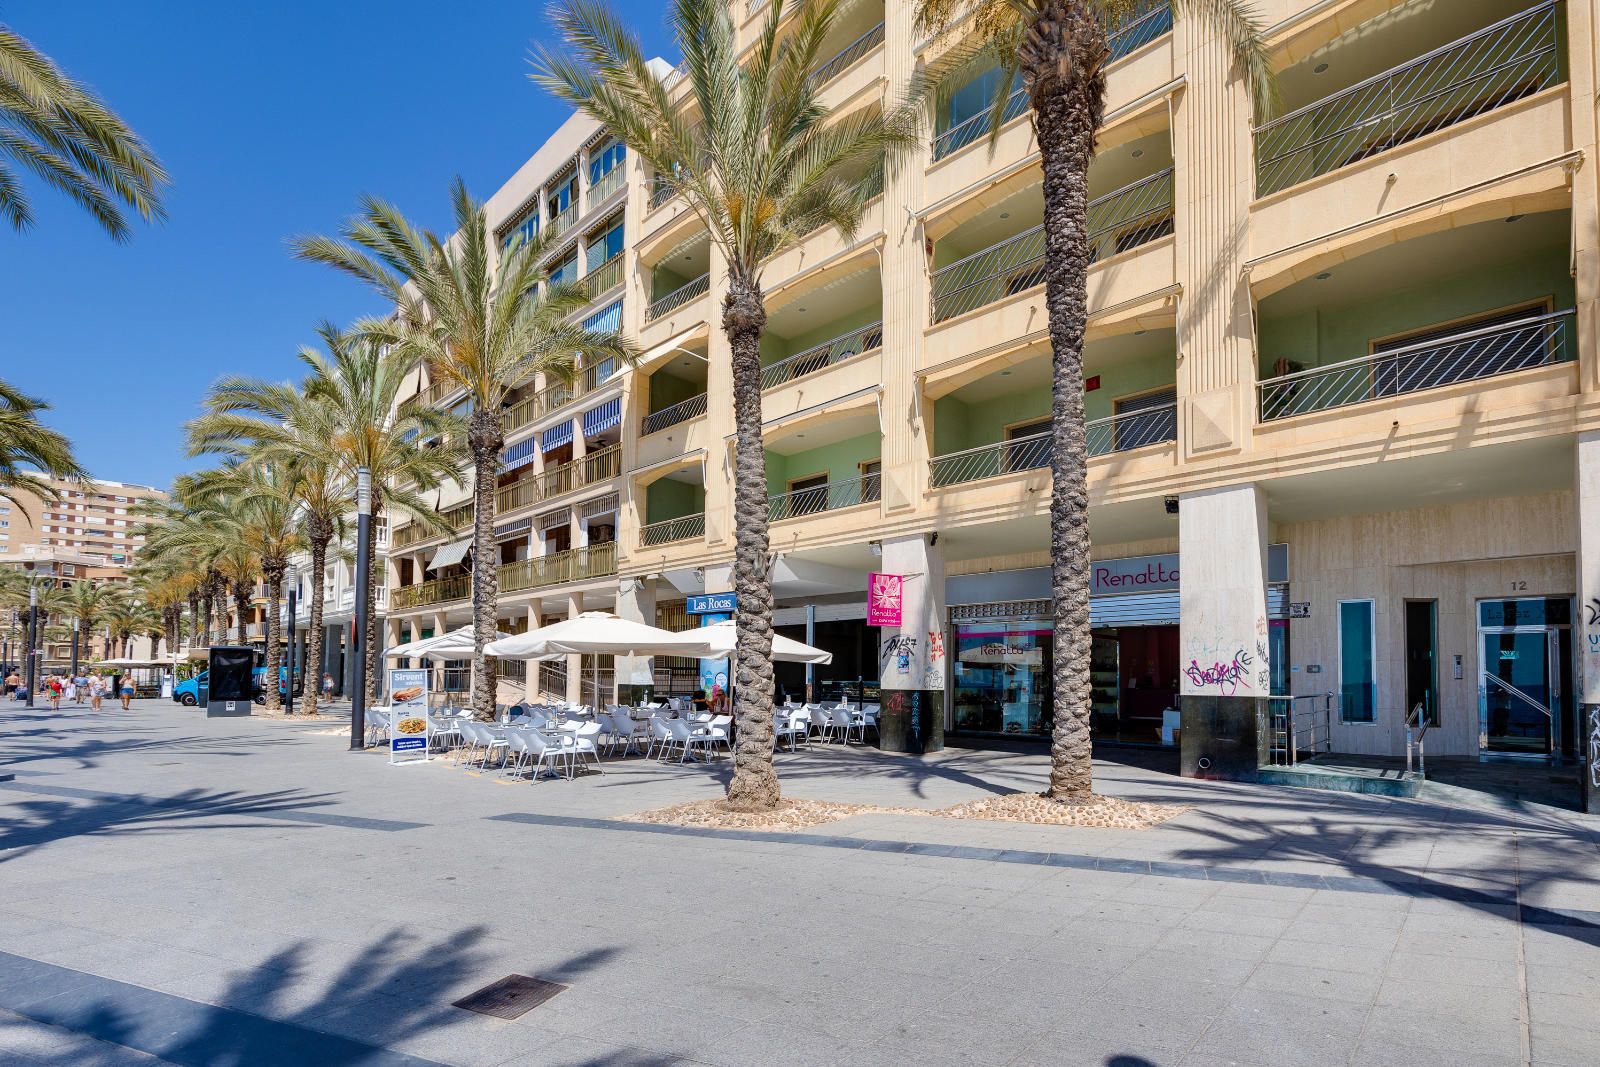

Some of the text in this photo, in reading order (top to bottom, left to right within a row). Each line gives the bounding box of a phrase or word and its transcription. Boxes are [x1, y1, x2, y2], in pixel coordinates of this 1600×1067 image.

[1511, 581, 1527, 591] 12
[693, 597, 731, 610] Las Rocas
